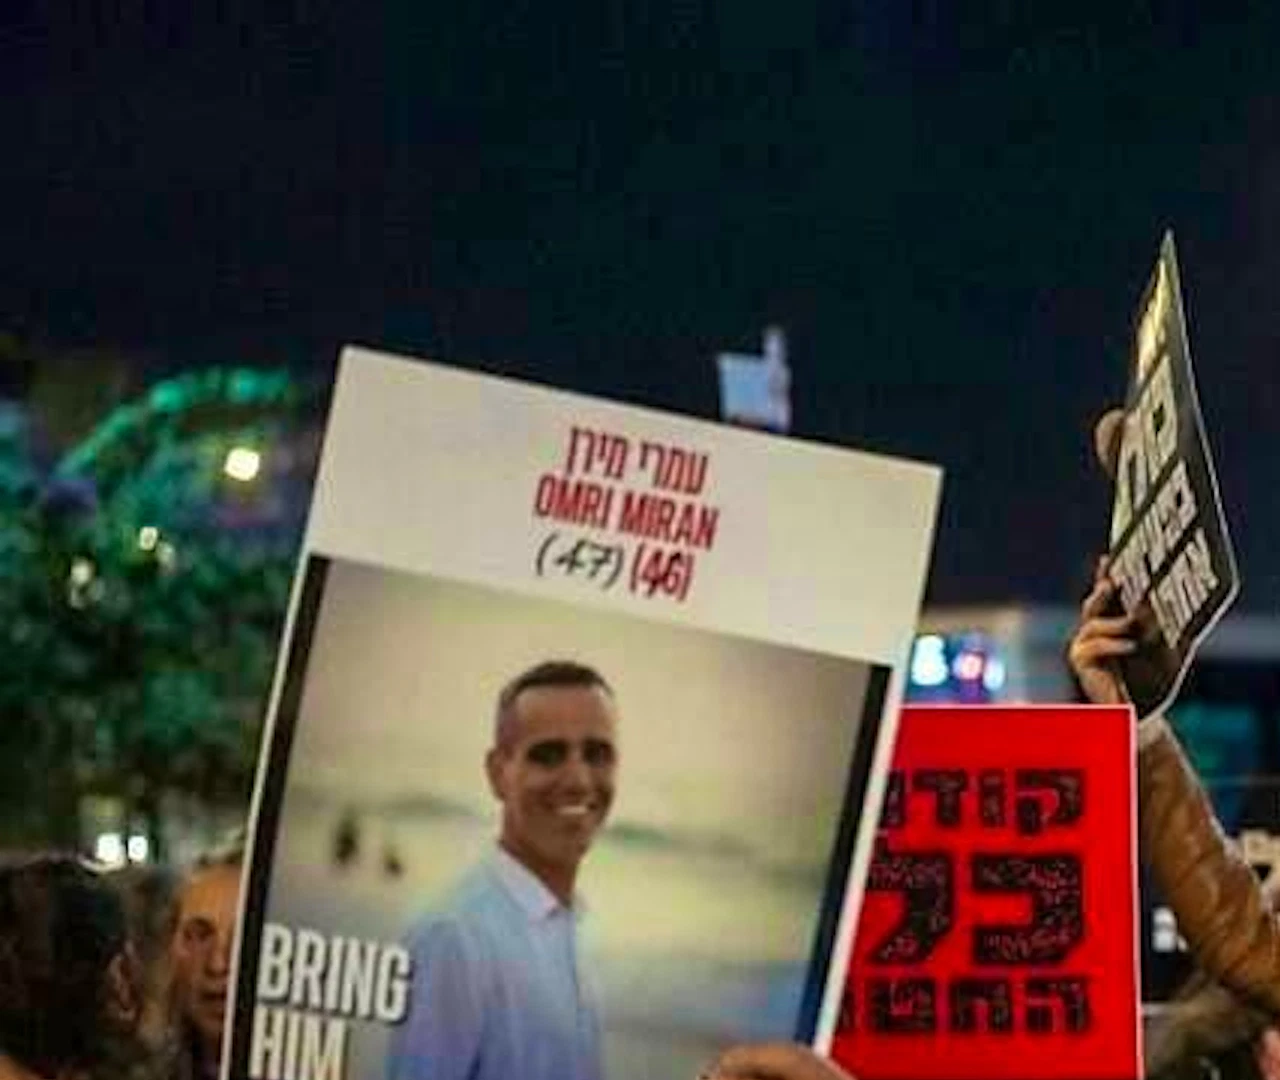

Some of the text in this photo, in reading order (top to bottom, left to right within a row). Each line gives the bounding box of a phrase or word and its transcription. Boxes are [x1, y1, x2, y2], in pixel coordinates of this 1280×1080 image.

[566, 425, 708, 495] עמרי מירן
[535, 474, 720, 550] OMRI MIRAN
[536, 533, 624, 590] (47)
[866, 835, 1084, 966] כל
[256, 921, 414, 1027] BRING
